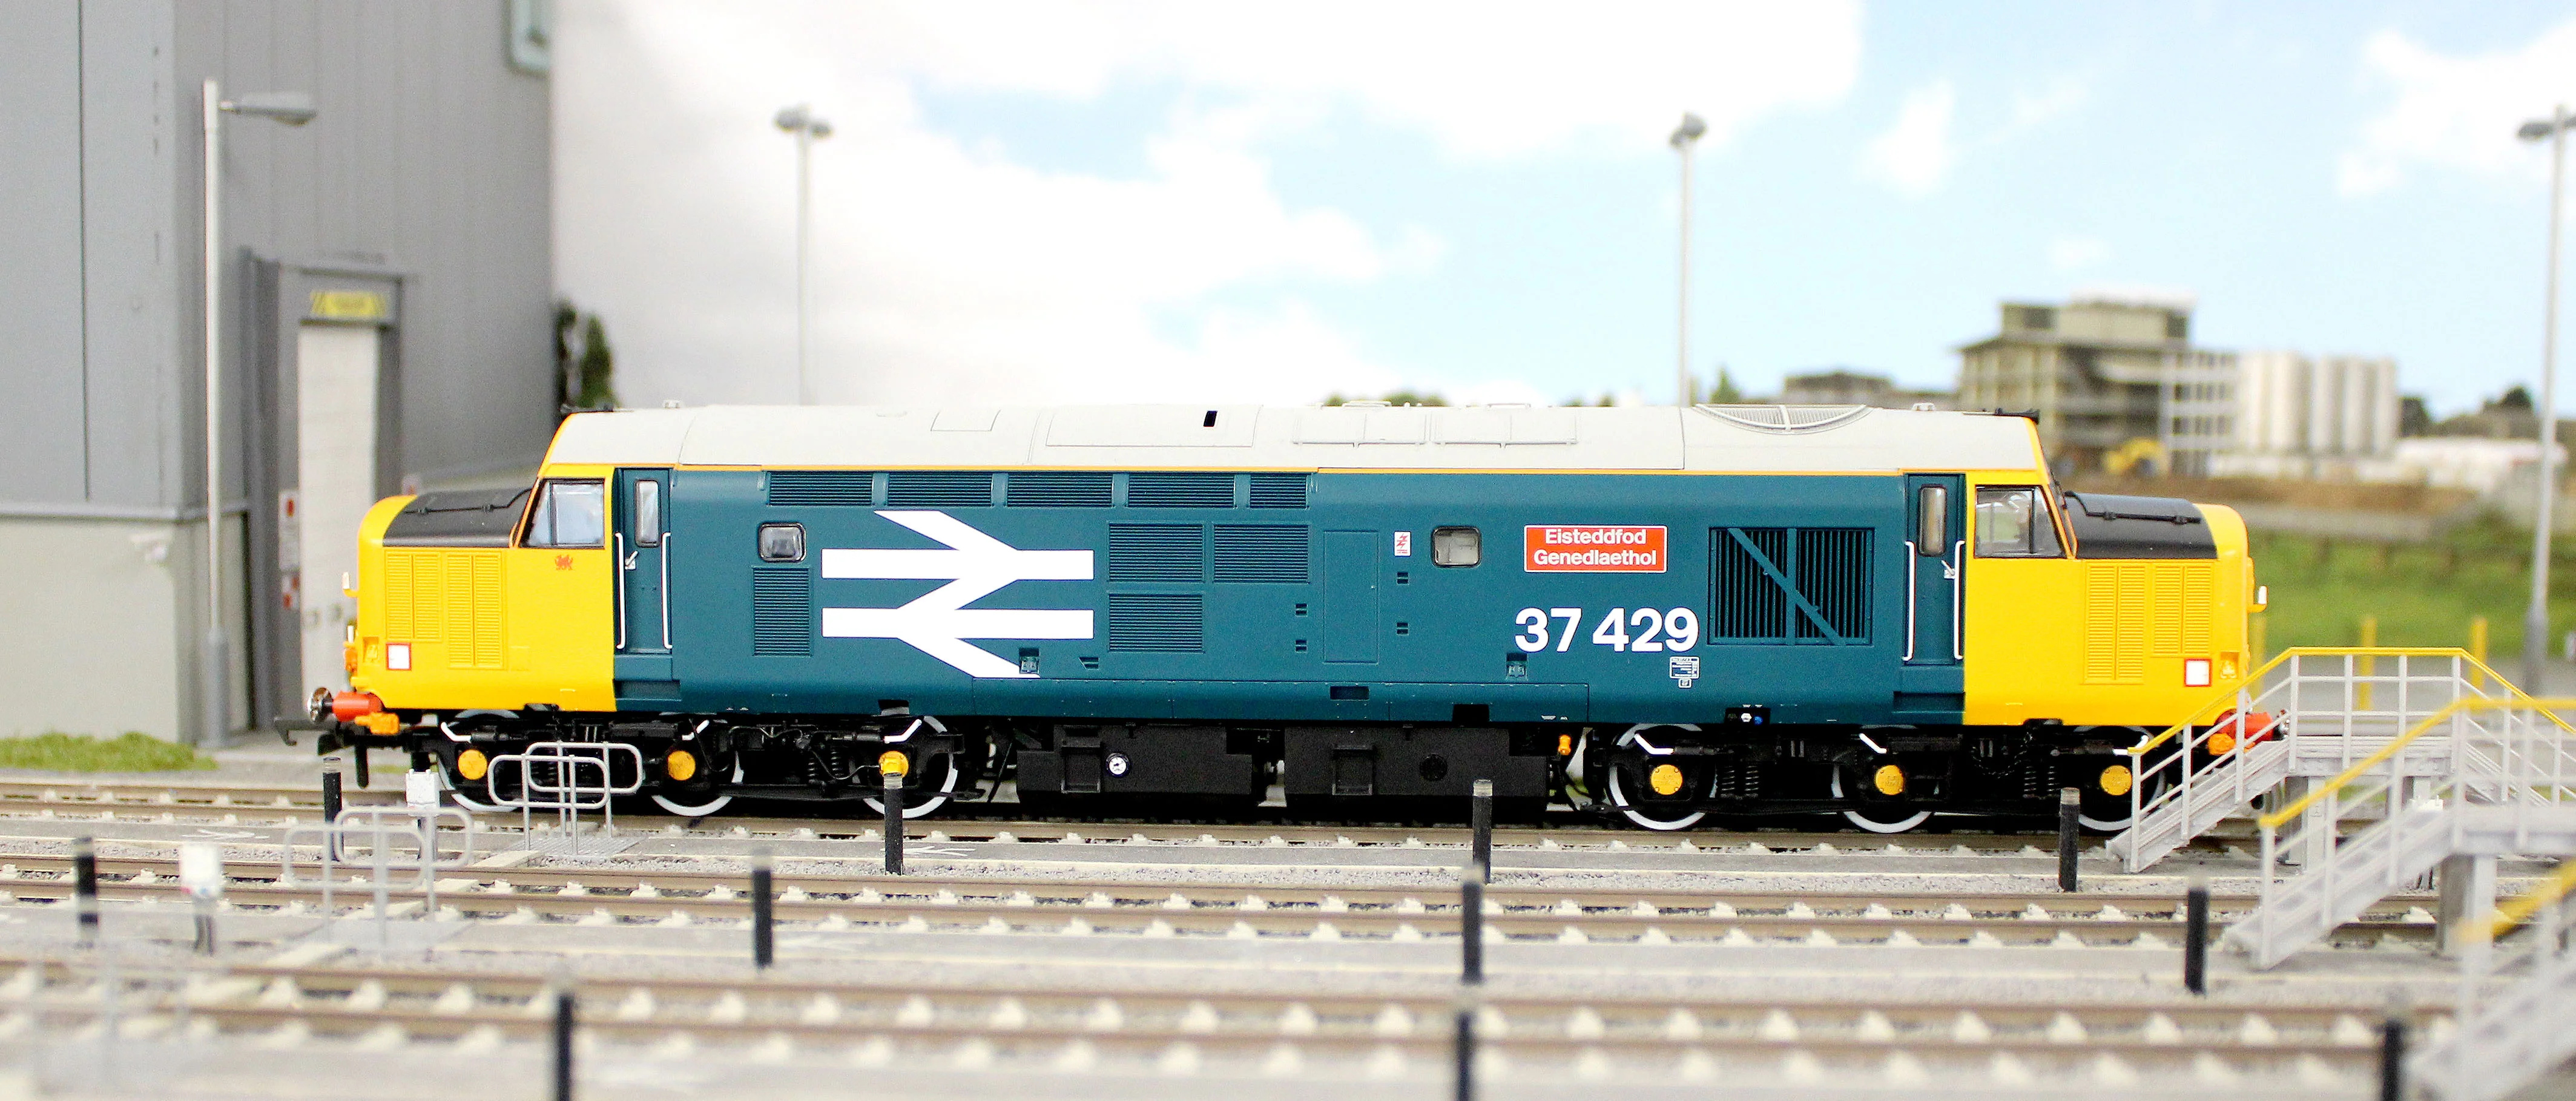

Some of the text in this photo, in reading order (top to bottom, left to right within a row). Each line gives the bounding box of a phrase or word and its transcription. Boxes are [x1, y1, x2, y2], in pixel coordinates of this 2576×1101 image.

[1545, 528, 1646, 544] Eisteddfod
[1533, 549, 1656, 565] Genedlaethol
[1515, 607, 1699, 652] 37 429
